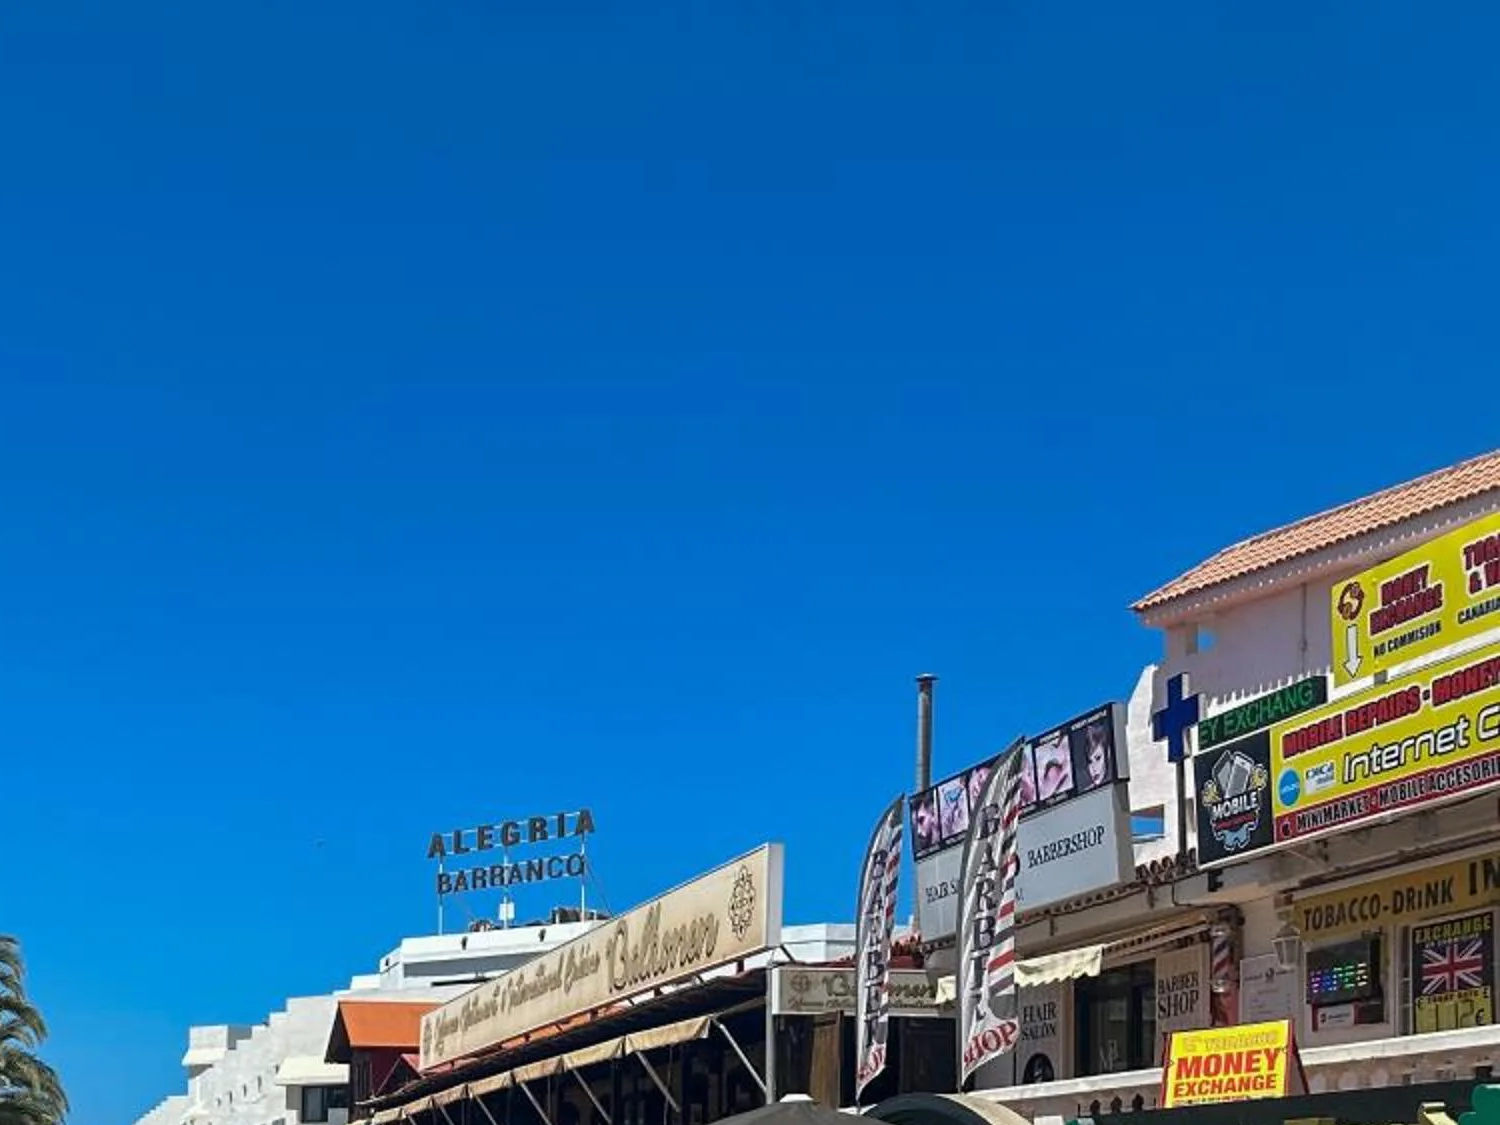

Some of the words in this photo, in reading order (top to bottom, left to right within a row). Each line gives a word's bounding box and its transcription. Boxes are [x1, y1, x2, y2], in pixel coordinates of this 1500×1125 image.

[1282, 713, 1343, 759] MOBILE
[1344, 686, 1421, 737] REPAIRS
[1342, 714, 1470, 784] Internet
[1211, 792, 1258, 820] MOBILE
[1296, 792, 1370, 834] MINIMARKET
[1378, 779, 1427, 808] MOBILE
[427, 809, 595, 858] ALEGRIA
[1027, 825, 1105, 868] BARBERSHOP
[436, 853, 585, 894] BARRANCO
[1158, 971, 1199, 995] BARBER
[1023, 1002, 1057, 1023] HAIR
[1158, 990, 1199, 1019] SHOP
[1022, 1023, 1057, 1041] SALON
[1176, 1047, 1280, 1080] MONEY
[1173, 1073, 1277, 1098] EXCHANGE
